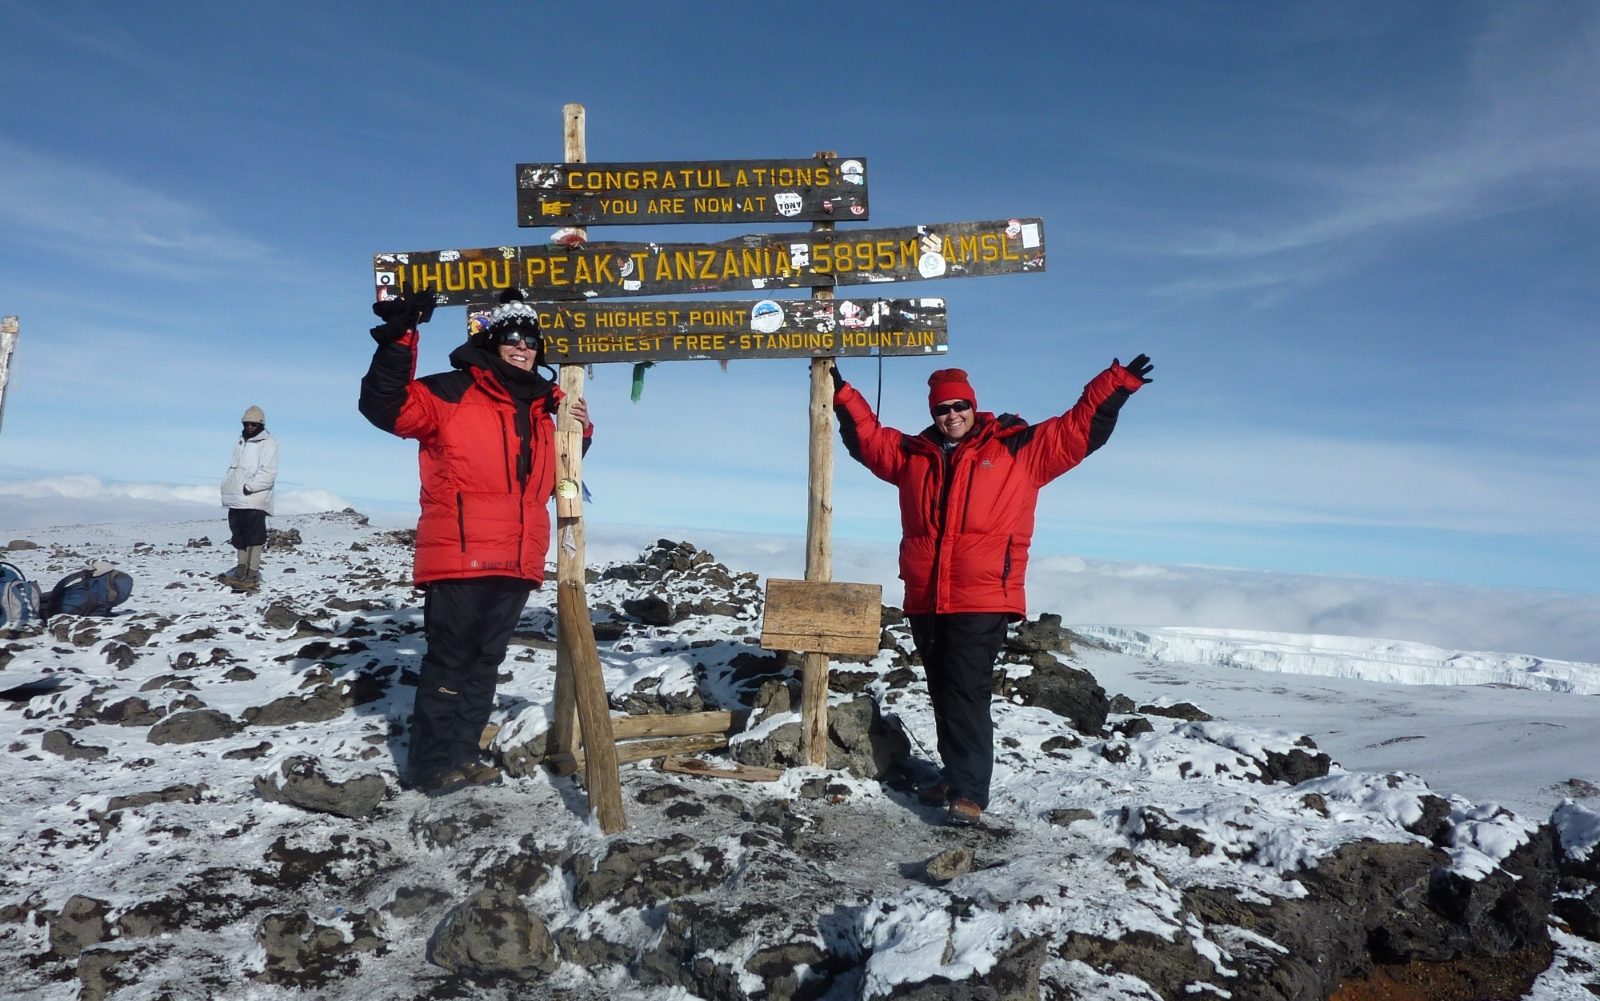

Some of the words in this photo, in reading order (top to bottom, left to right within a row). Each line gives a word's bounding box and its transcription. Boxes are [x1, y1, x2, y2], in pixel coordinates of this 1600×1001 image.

[600, 199, 638, 215] YOU
[648, 198, 685, 214] ARE
[693, 197, 736, 213] NOW
[743, 196, 767, 212] AT
[397, 258, 512, 294] UHURU
[539, 308, 587, 329] CA'S
[595, 310, 681, 328] HIGHEST
[689, 309, 747, 327] POINT
[577, 334, 662, 353] HIGHEST
[842, 330, 936, 348] MOUNTAIN
